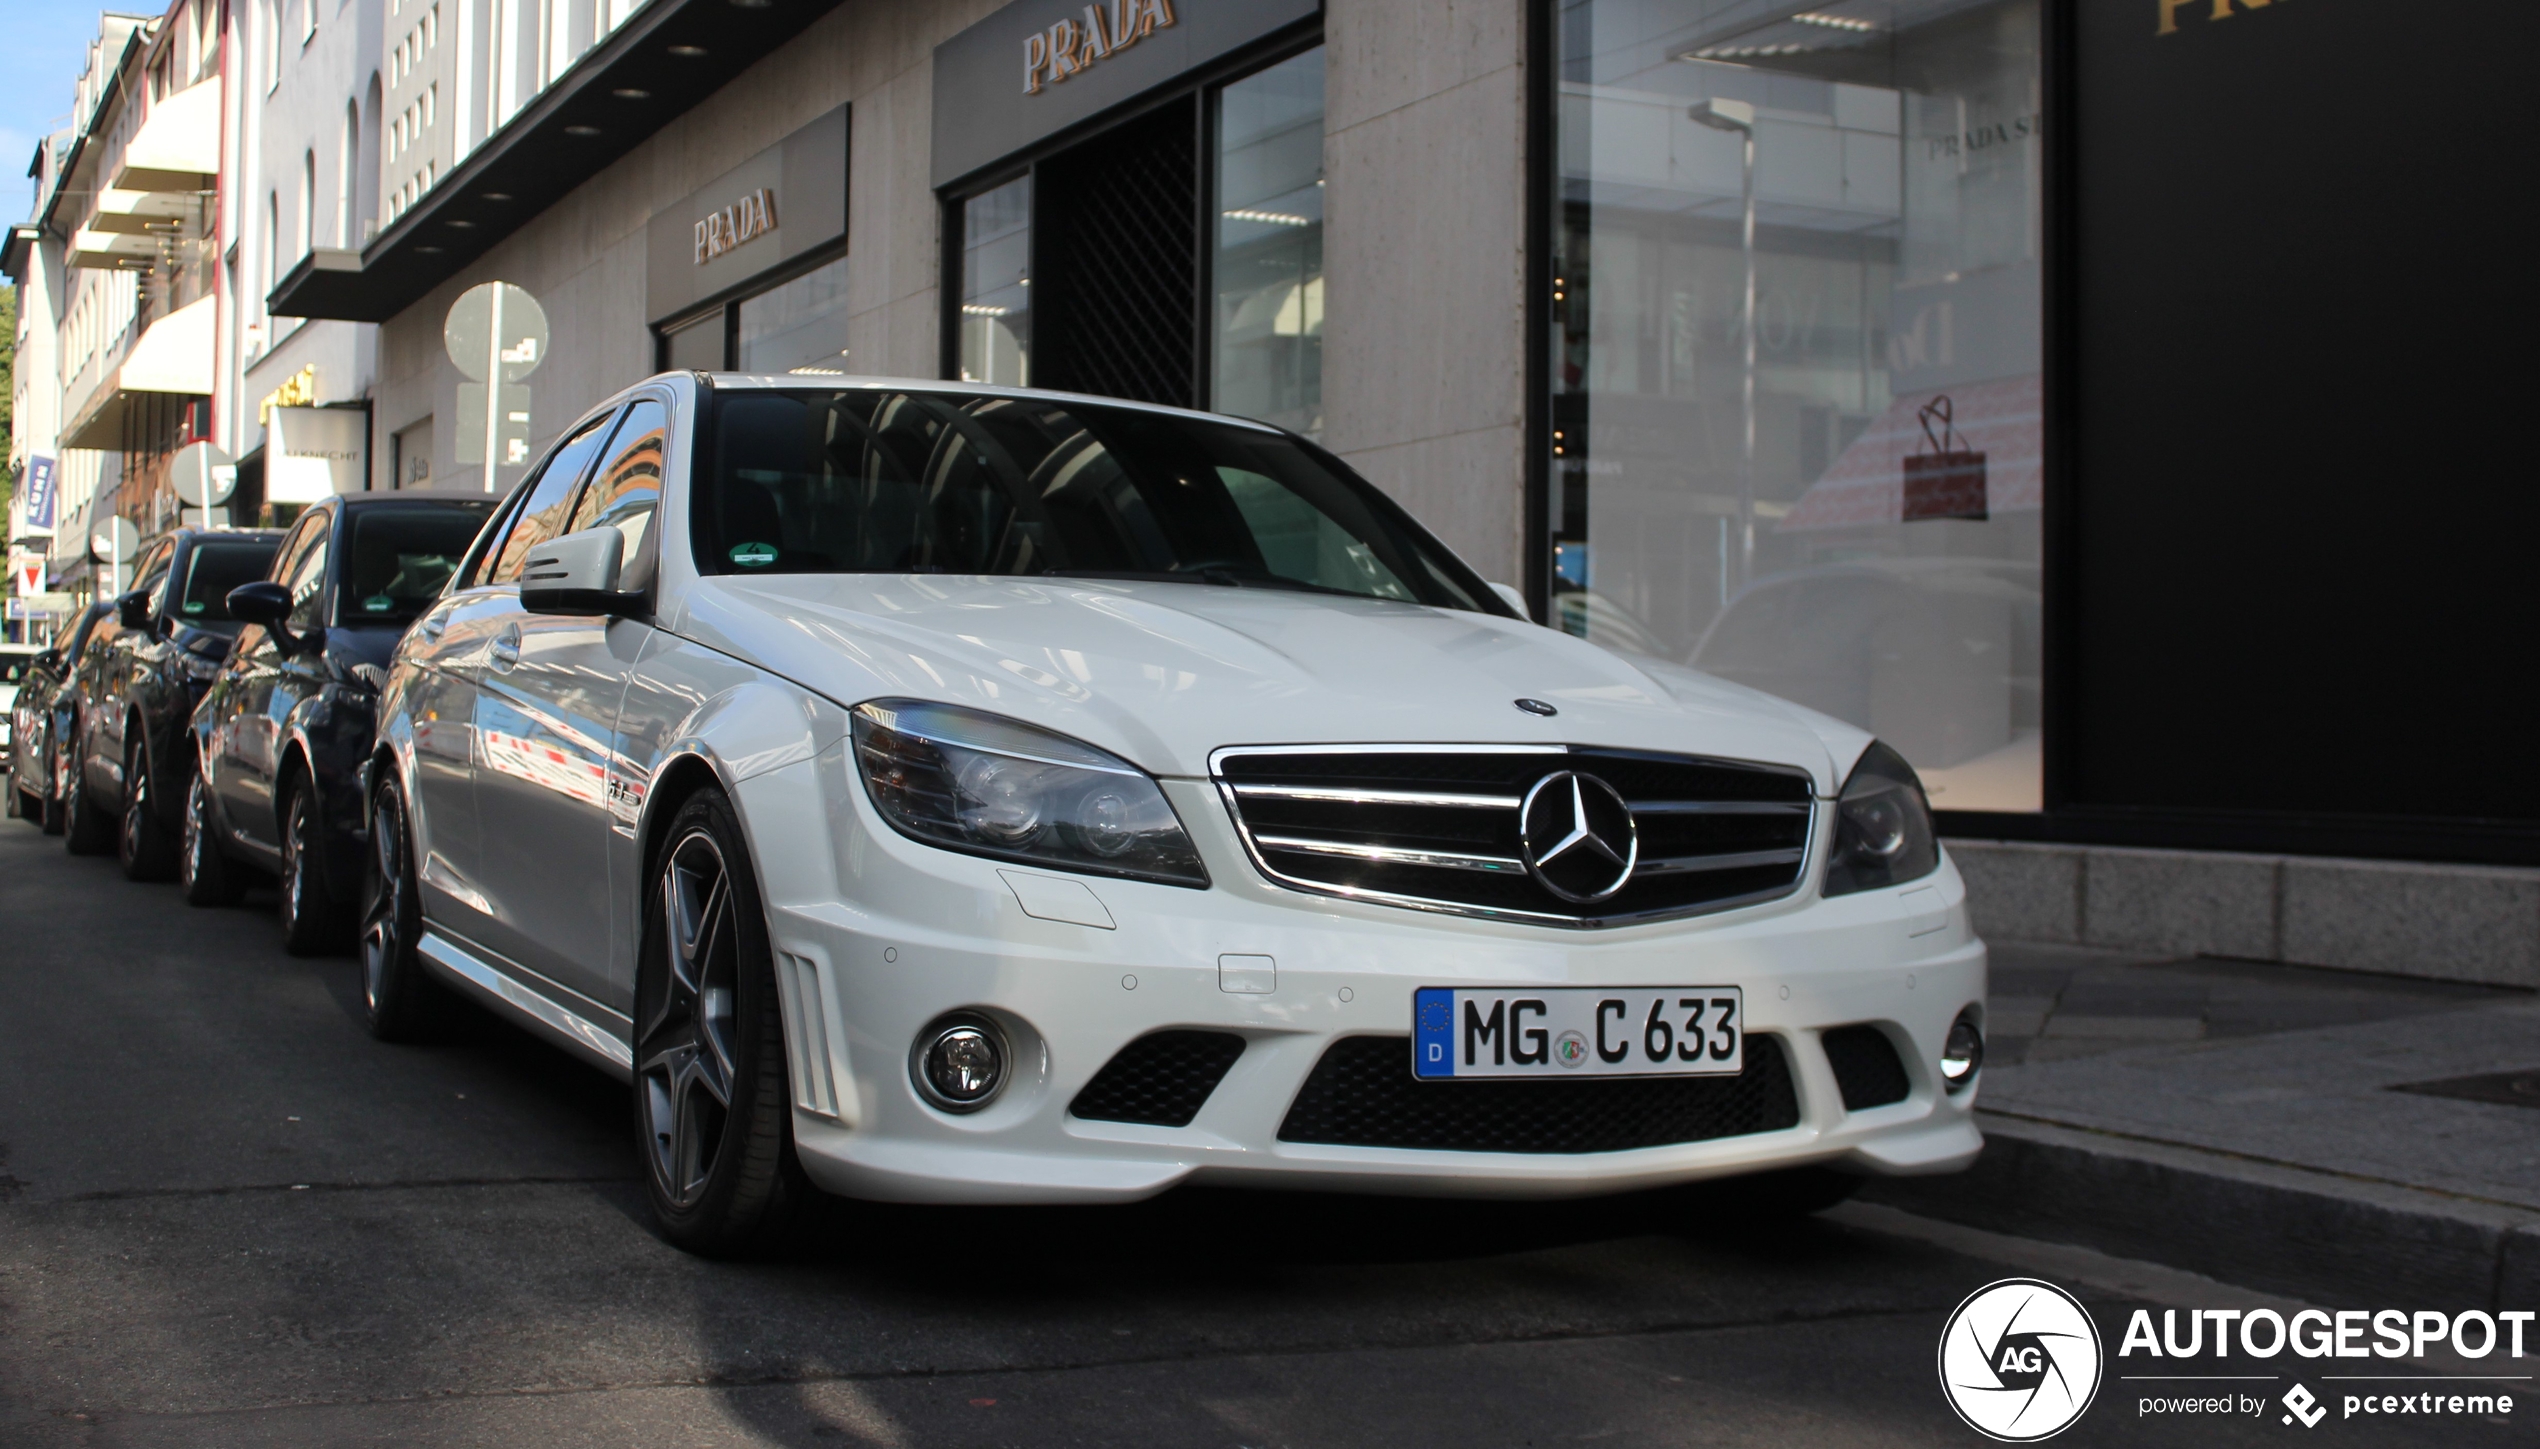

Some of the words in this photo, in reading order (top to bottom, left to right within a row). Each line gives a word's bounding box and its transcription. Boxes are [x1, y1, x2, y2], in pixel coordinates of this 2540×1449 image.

[1022, 0, 1173, 95] PRADA
[693, 187, 776, 265] PRADA
[1428, 1043, 1443, 1063] D
[1464, 998, 1549, 1066] MG
[1596, 998, 1629, 1064] C
[1644, 997, 1736, 1062] 633
